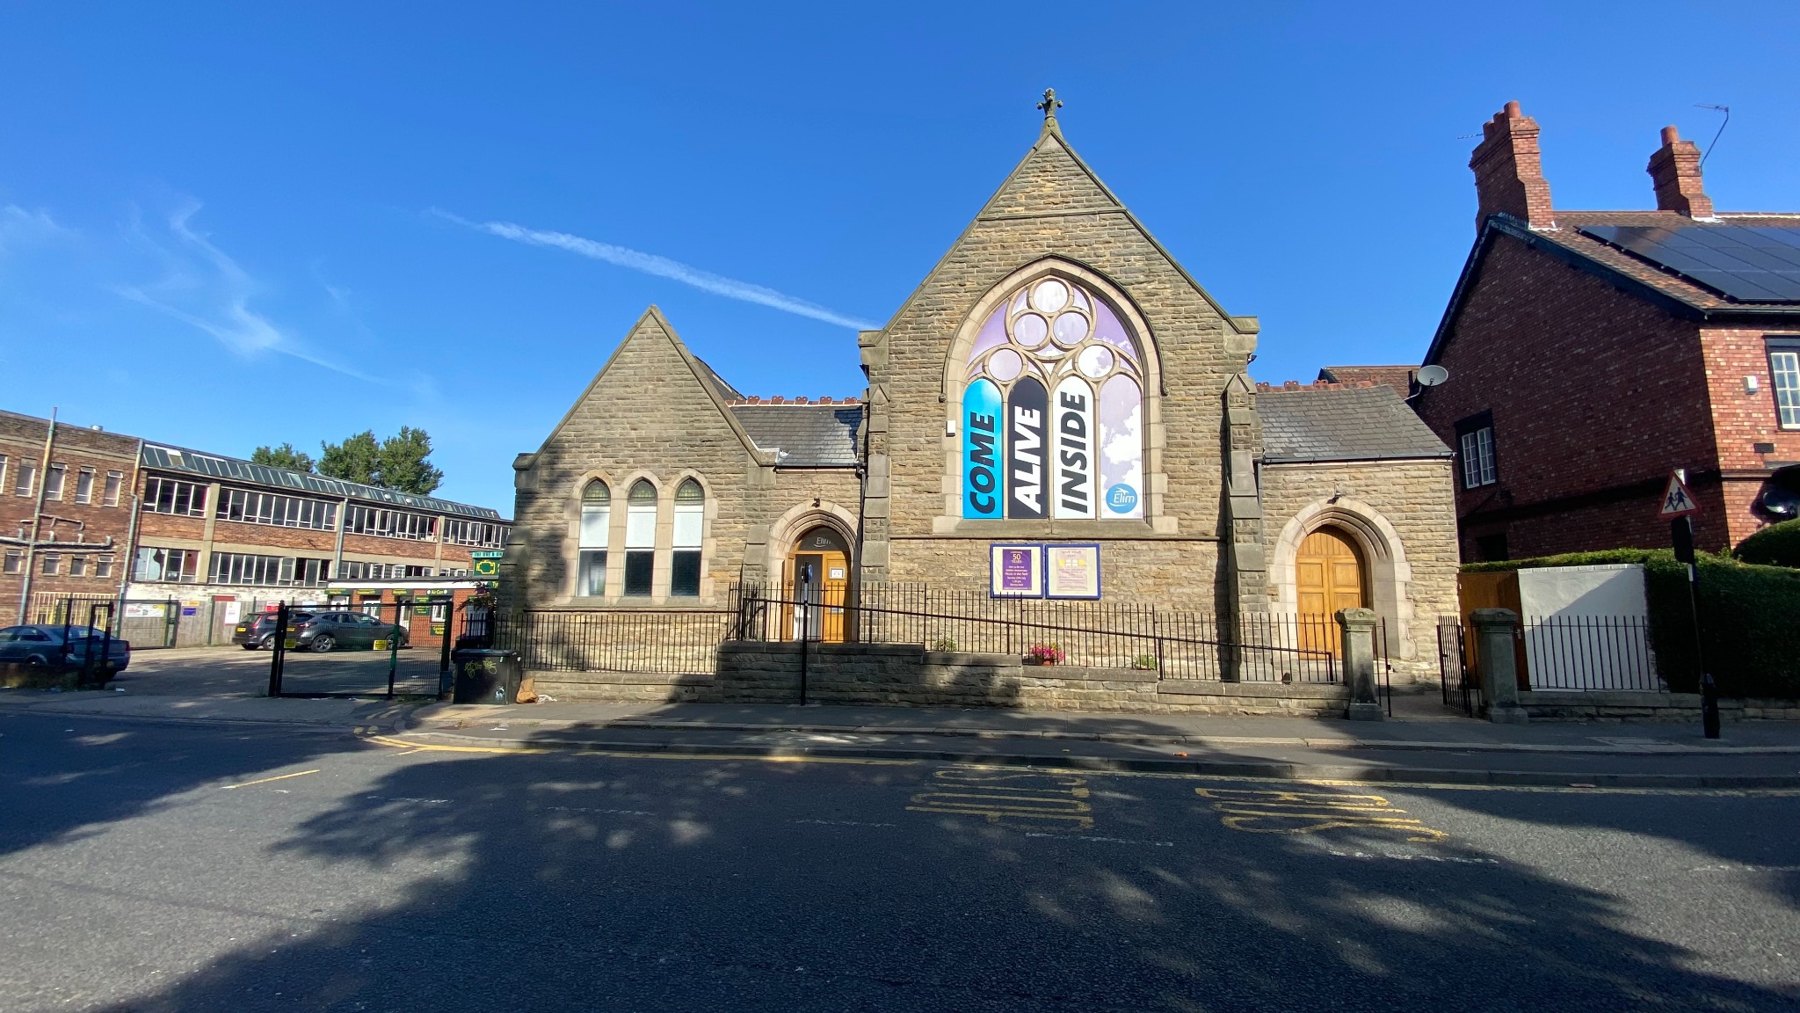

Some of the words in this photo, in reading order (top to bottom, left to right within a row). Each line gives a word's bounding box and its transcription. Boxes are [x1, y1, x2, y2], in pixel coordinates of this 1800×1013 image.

[970, 412, 996, 514] COME
[1014, 406, 1041, 514] ALIVE
[1061, 391, 1088, 514] INSIDE
[1113, 492, 1135, 504] Elim
[905, 770, 1095, 832] STOP
[1194, 787, 1449, 843] BUS
